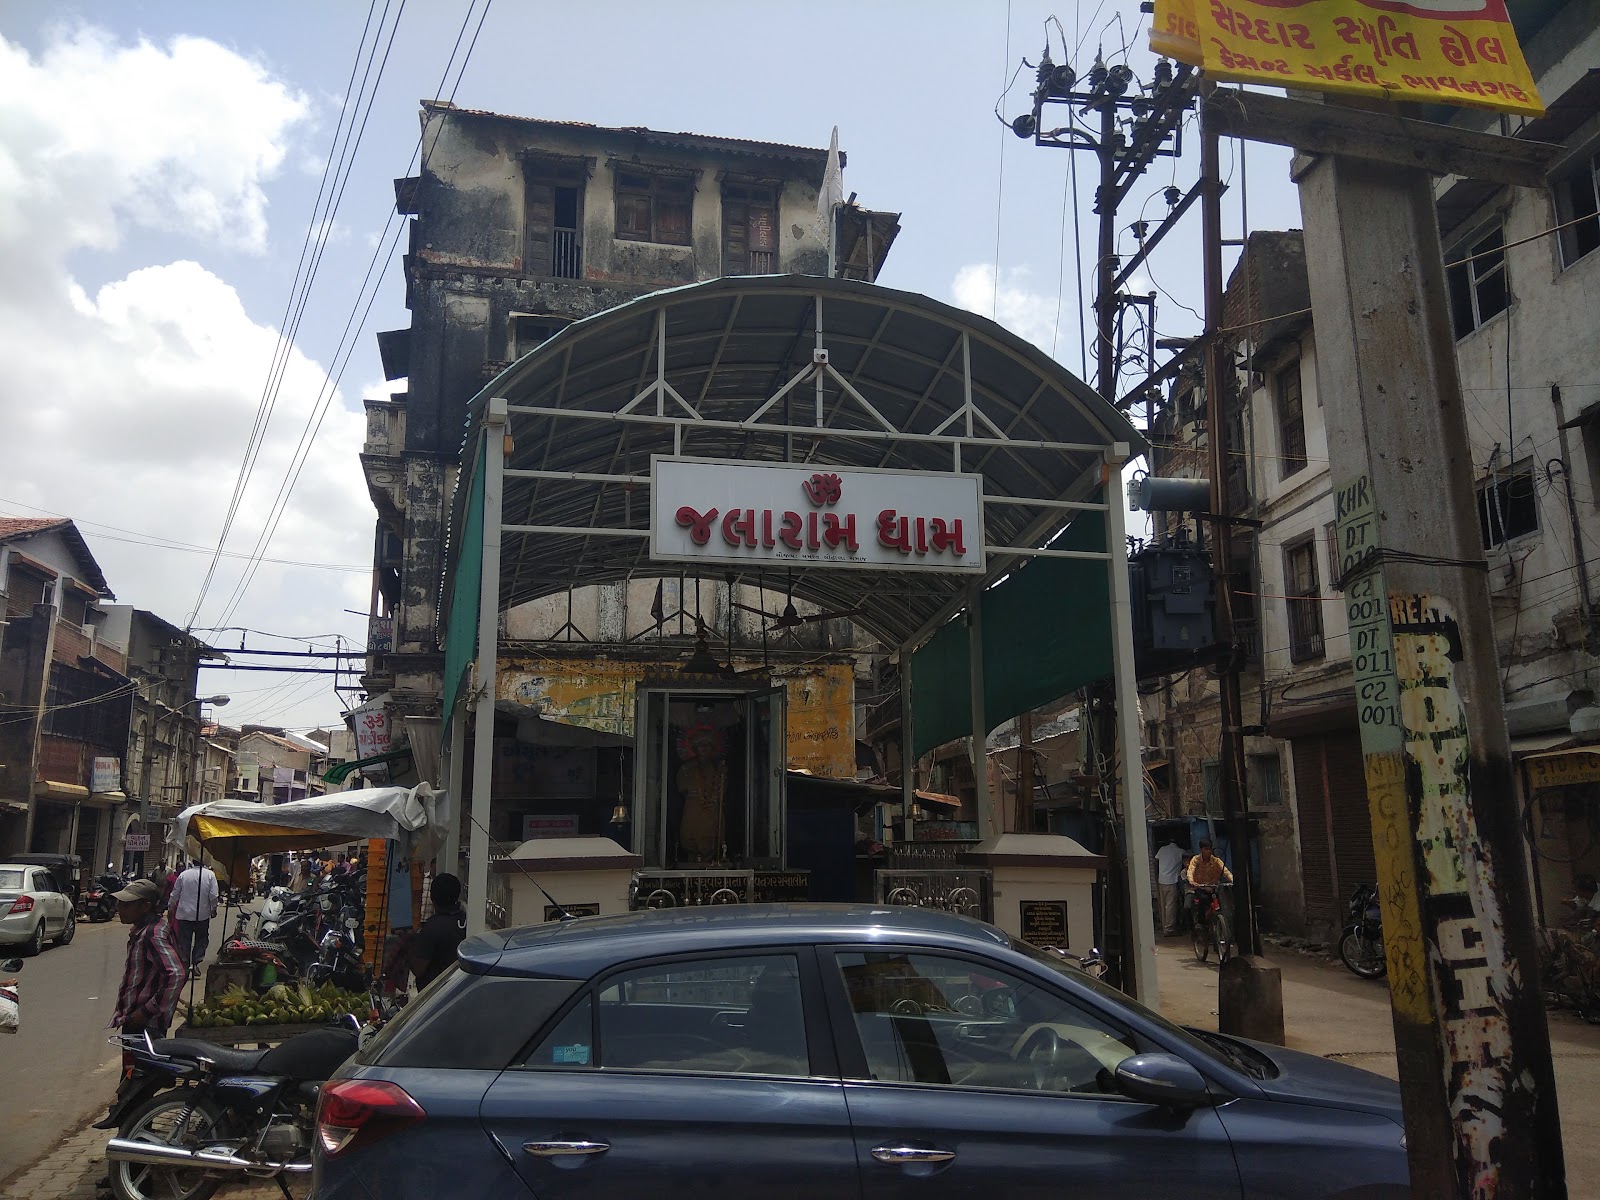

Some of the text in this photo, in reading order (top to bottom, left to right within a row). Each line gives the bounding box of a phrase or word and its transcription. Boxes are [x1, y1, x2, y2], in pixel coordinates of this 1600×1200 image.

[1208, 0, 1316, 50] સરદાર
[1439, 24, 1508, 67] હોલ
[1401, 74, 1529, 103] ભાવનગર
[675, 505, 967, 557] જલારામ ધામ
[1345, 521, 1371, 550] DT
[1349, 599, 1384, 620] 001
[1357, 628, 1380, 650] DT
[1355, 652, 1393, 673] 011
[1361, 681, 1390, 700] C2
[1361, 705, 1399, 727] 001
